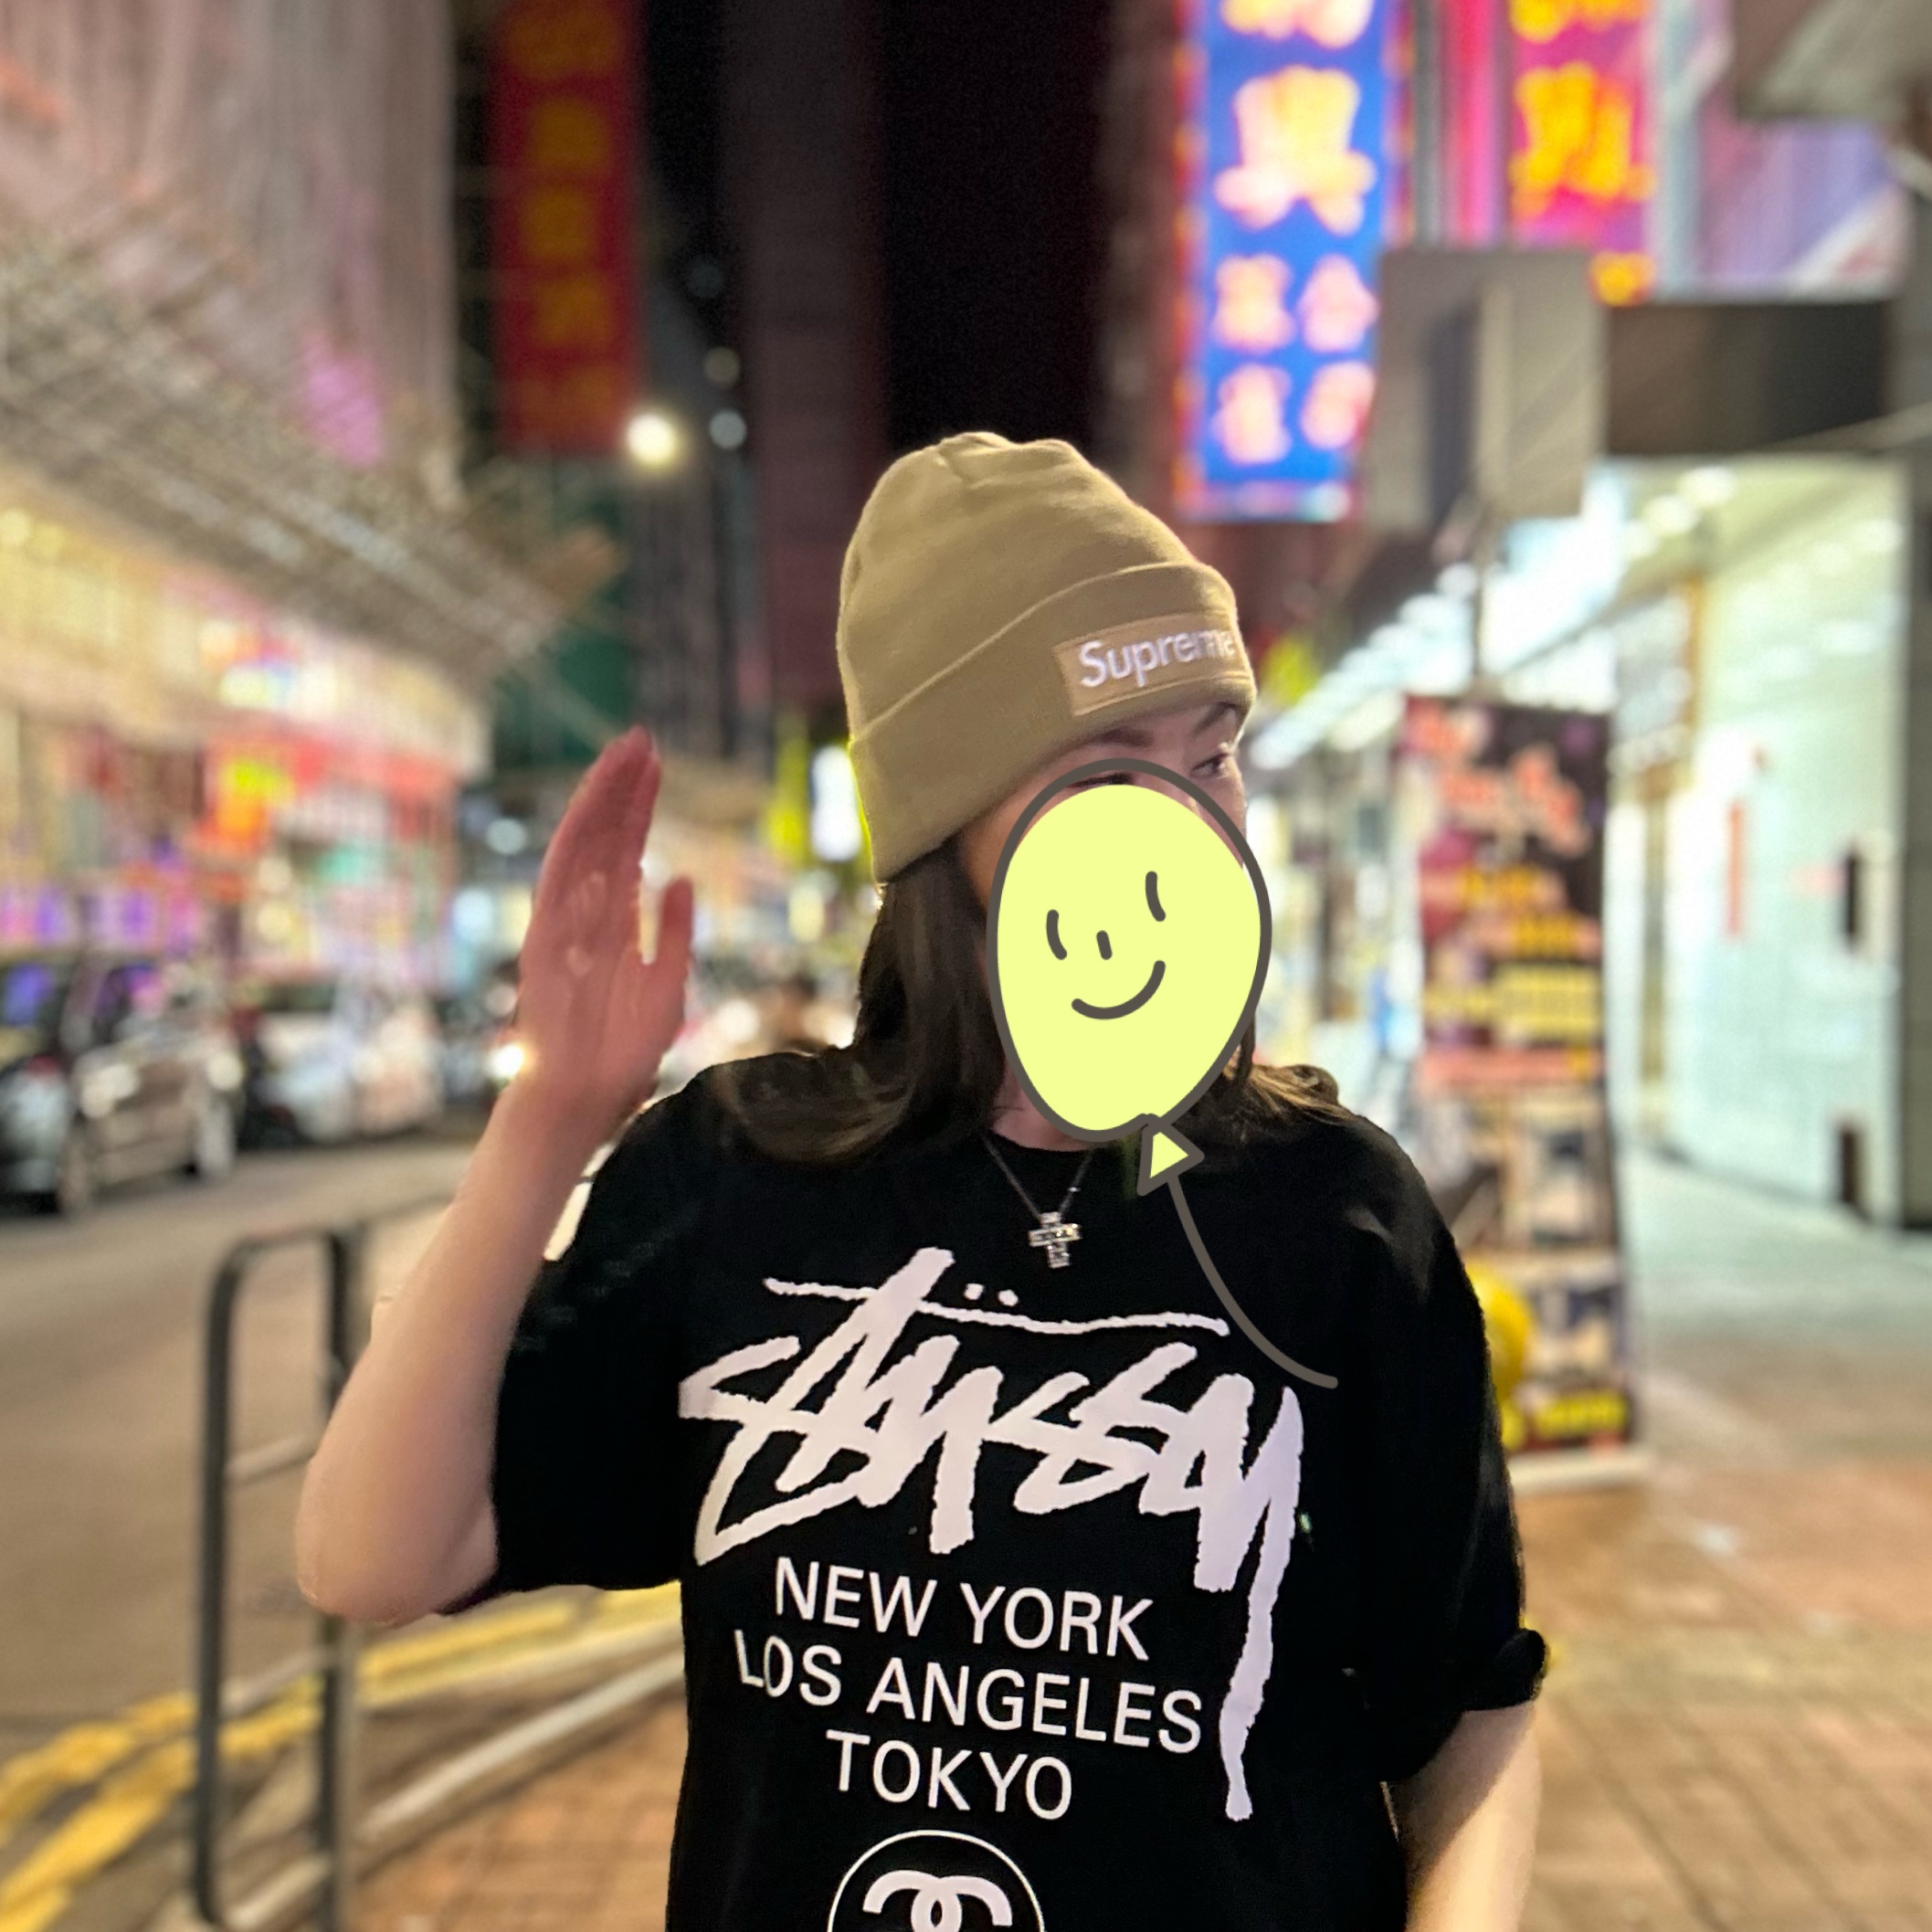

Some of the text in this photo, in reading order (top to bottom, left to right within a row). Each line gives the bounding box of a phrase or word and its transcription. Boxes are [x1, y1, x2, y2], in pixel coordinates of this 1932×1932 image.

[776, 1557, 1154, 1661] NEW YORK
[734, 1629, 1202, 1754] LOS ANGELES
[826, 1728, 1072, 1821] TOKYO
